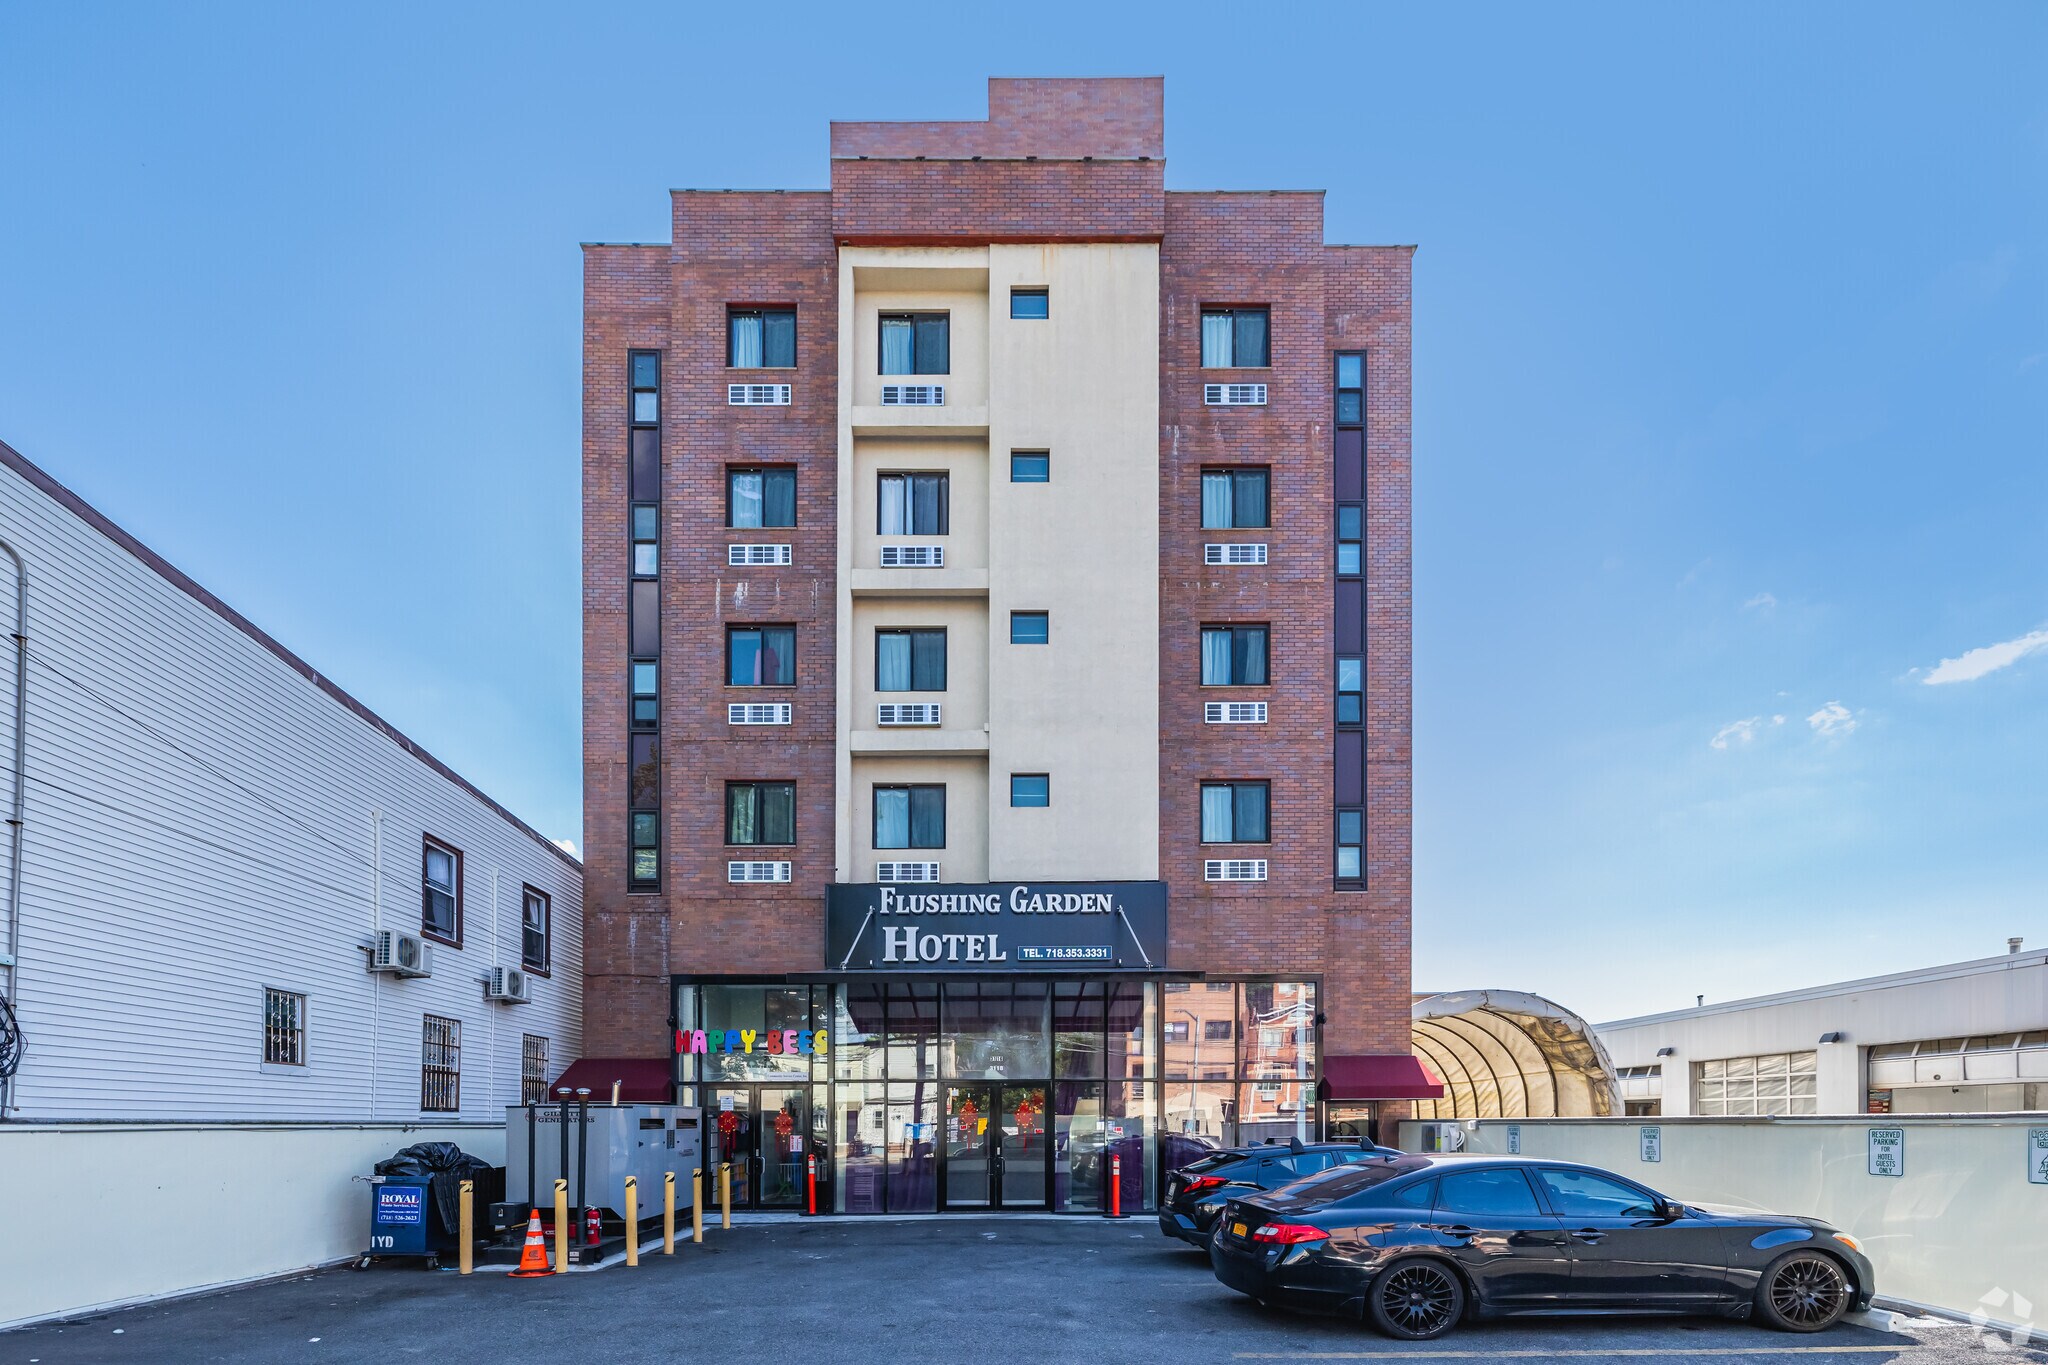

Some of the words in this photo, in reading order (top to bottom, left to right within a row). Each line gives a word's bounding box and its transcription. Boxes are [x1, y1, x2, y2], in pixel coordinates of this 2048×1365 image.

[879, 887, 1001, 915] FLUSHING
[1010, 886, 1114, 914] GARDEN
[882, 926, 1007, 962] HOTEL
[1023, 948, 1044, 958] TEL.
[1046, 948, 1107, 958] 718.353.3331
[675, 1029, 757, 1054] HAPPY
[767, 1029, 828, 1055] BEES
[380, 1194, 419, 1204] ROYAL
[377, 1236, 394, 1248] YD
